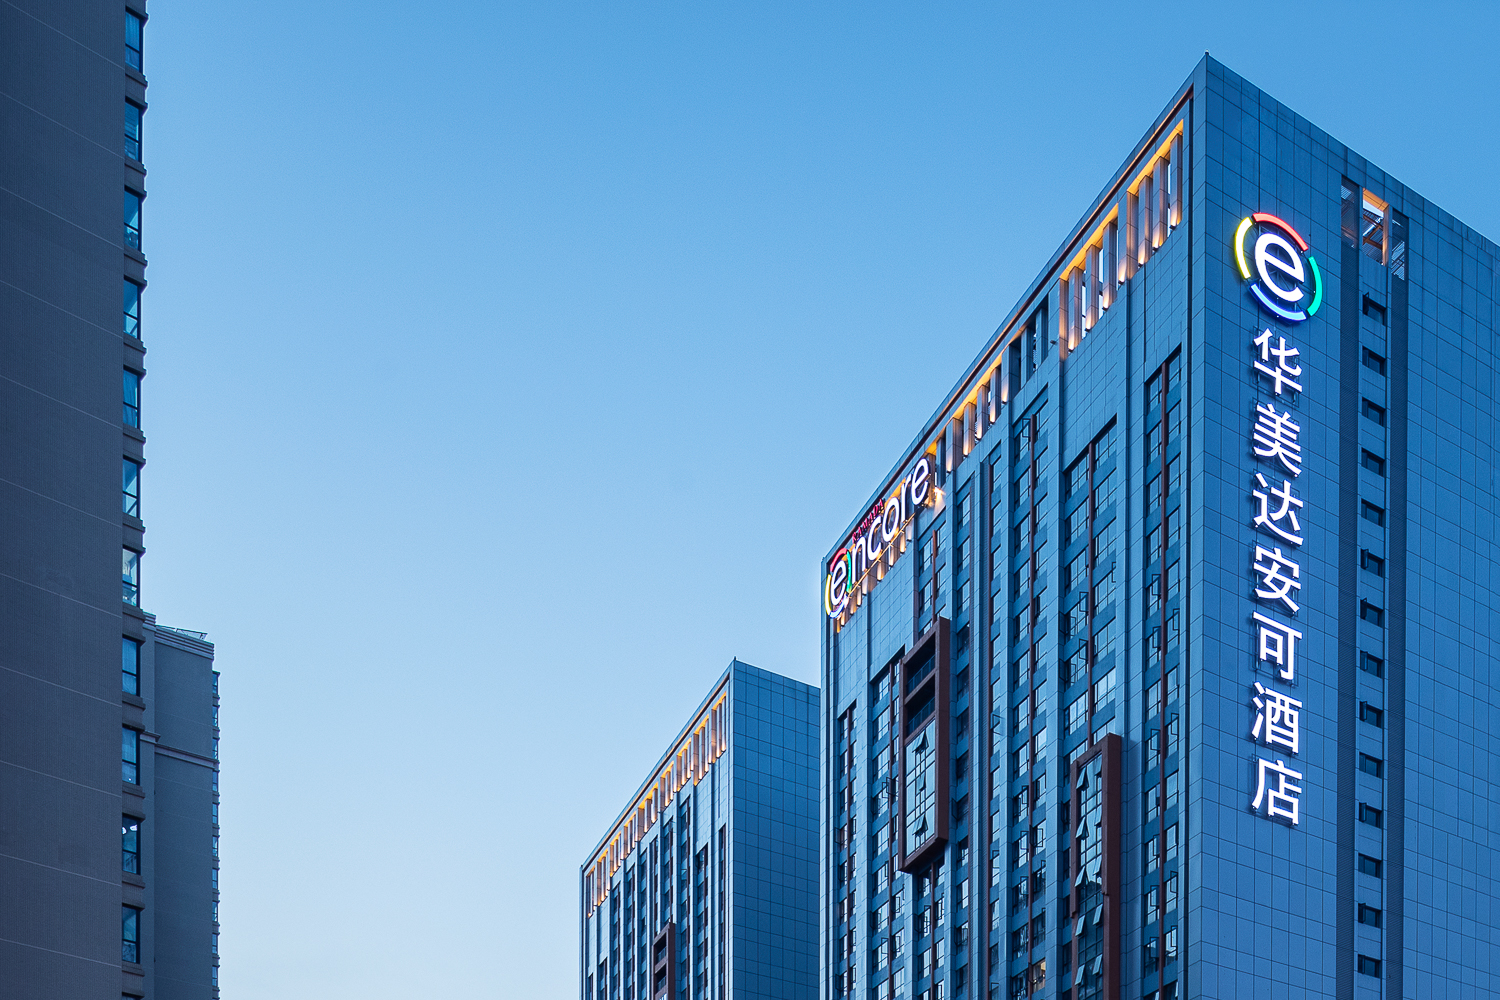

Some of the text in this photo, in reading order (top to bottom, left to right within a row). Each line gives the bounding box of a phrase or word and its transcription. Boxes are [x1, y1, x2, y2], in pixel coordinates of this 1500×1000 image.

[827, 457, 931, 607] encore
[1252, 327, 1304, 827] 华美达安可酒店
